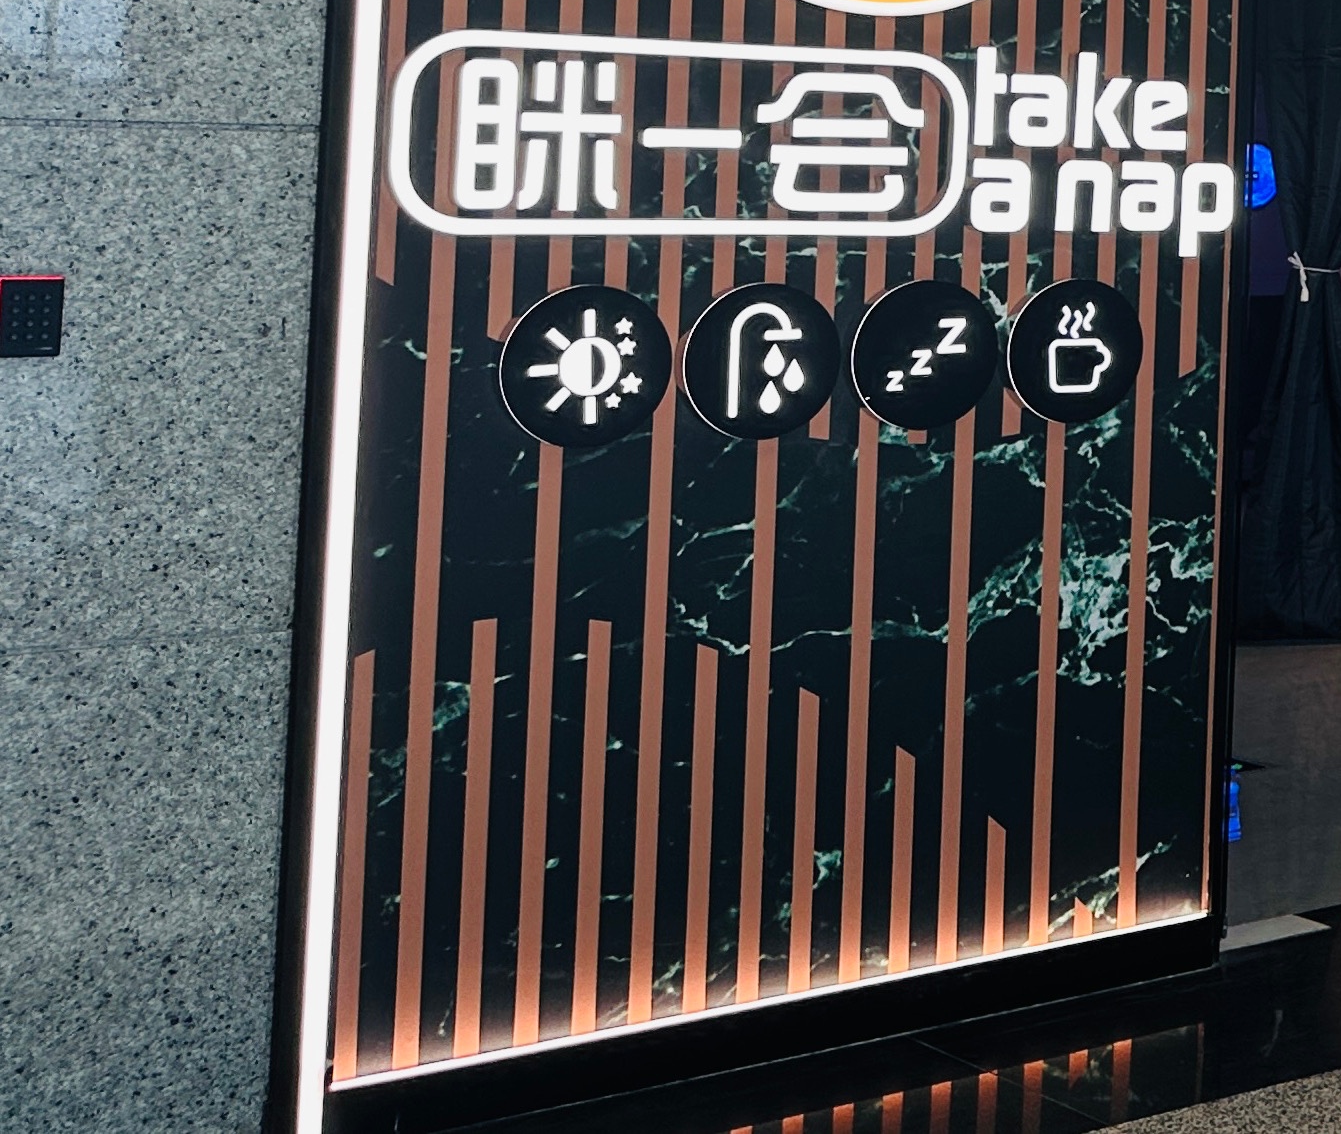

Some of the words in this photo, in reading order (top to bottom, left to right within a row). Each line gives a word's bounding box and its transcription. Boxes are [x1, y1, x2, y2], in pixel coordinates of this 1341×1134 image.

[455, 57, 926, 212] 眯一会
[972, 45, 1189, 152] take
[969, 157, 1032, 234] a
[1053, 158, 1236, 258] nap
